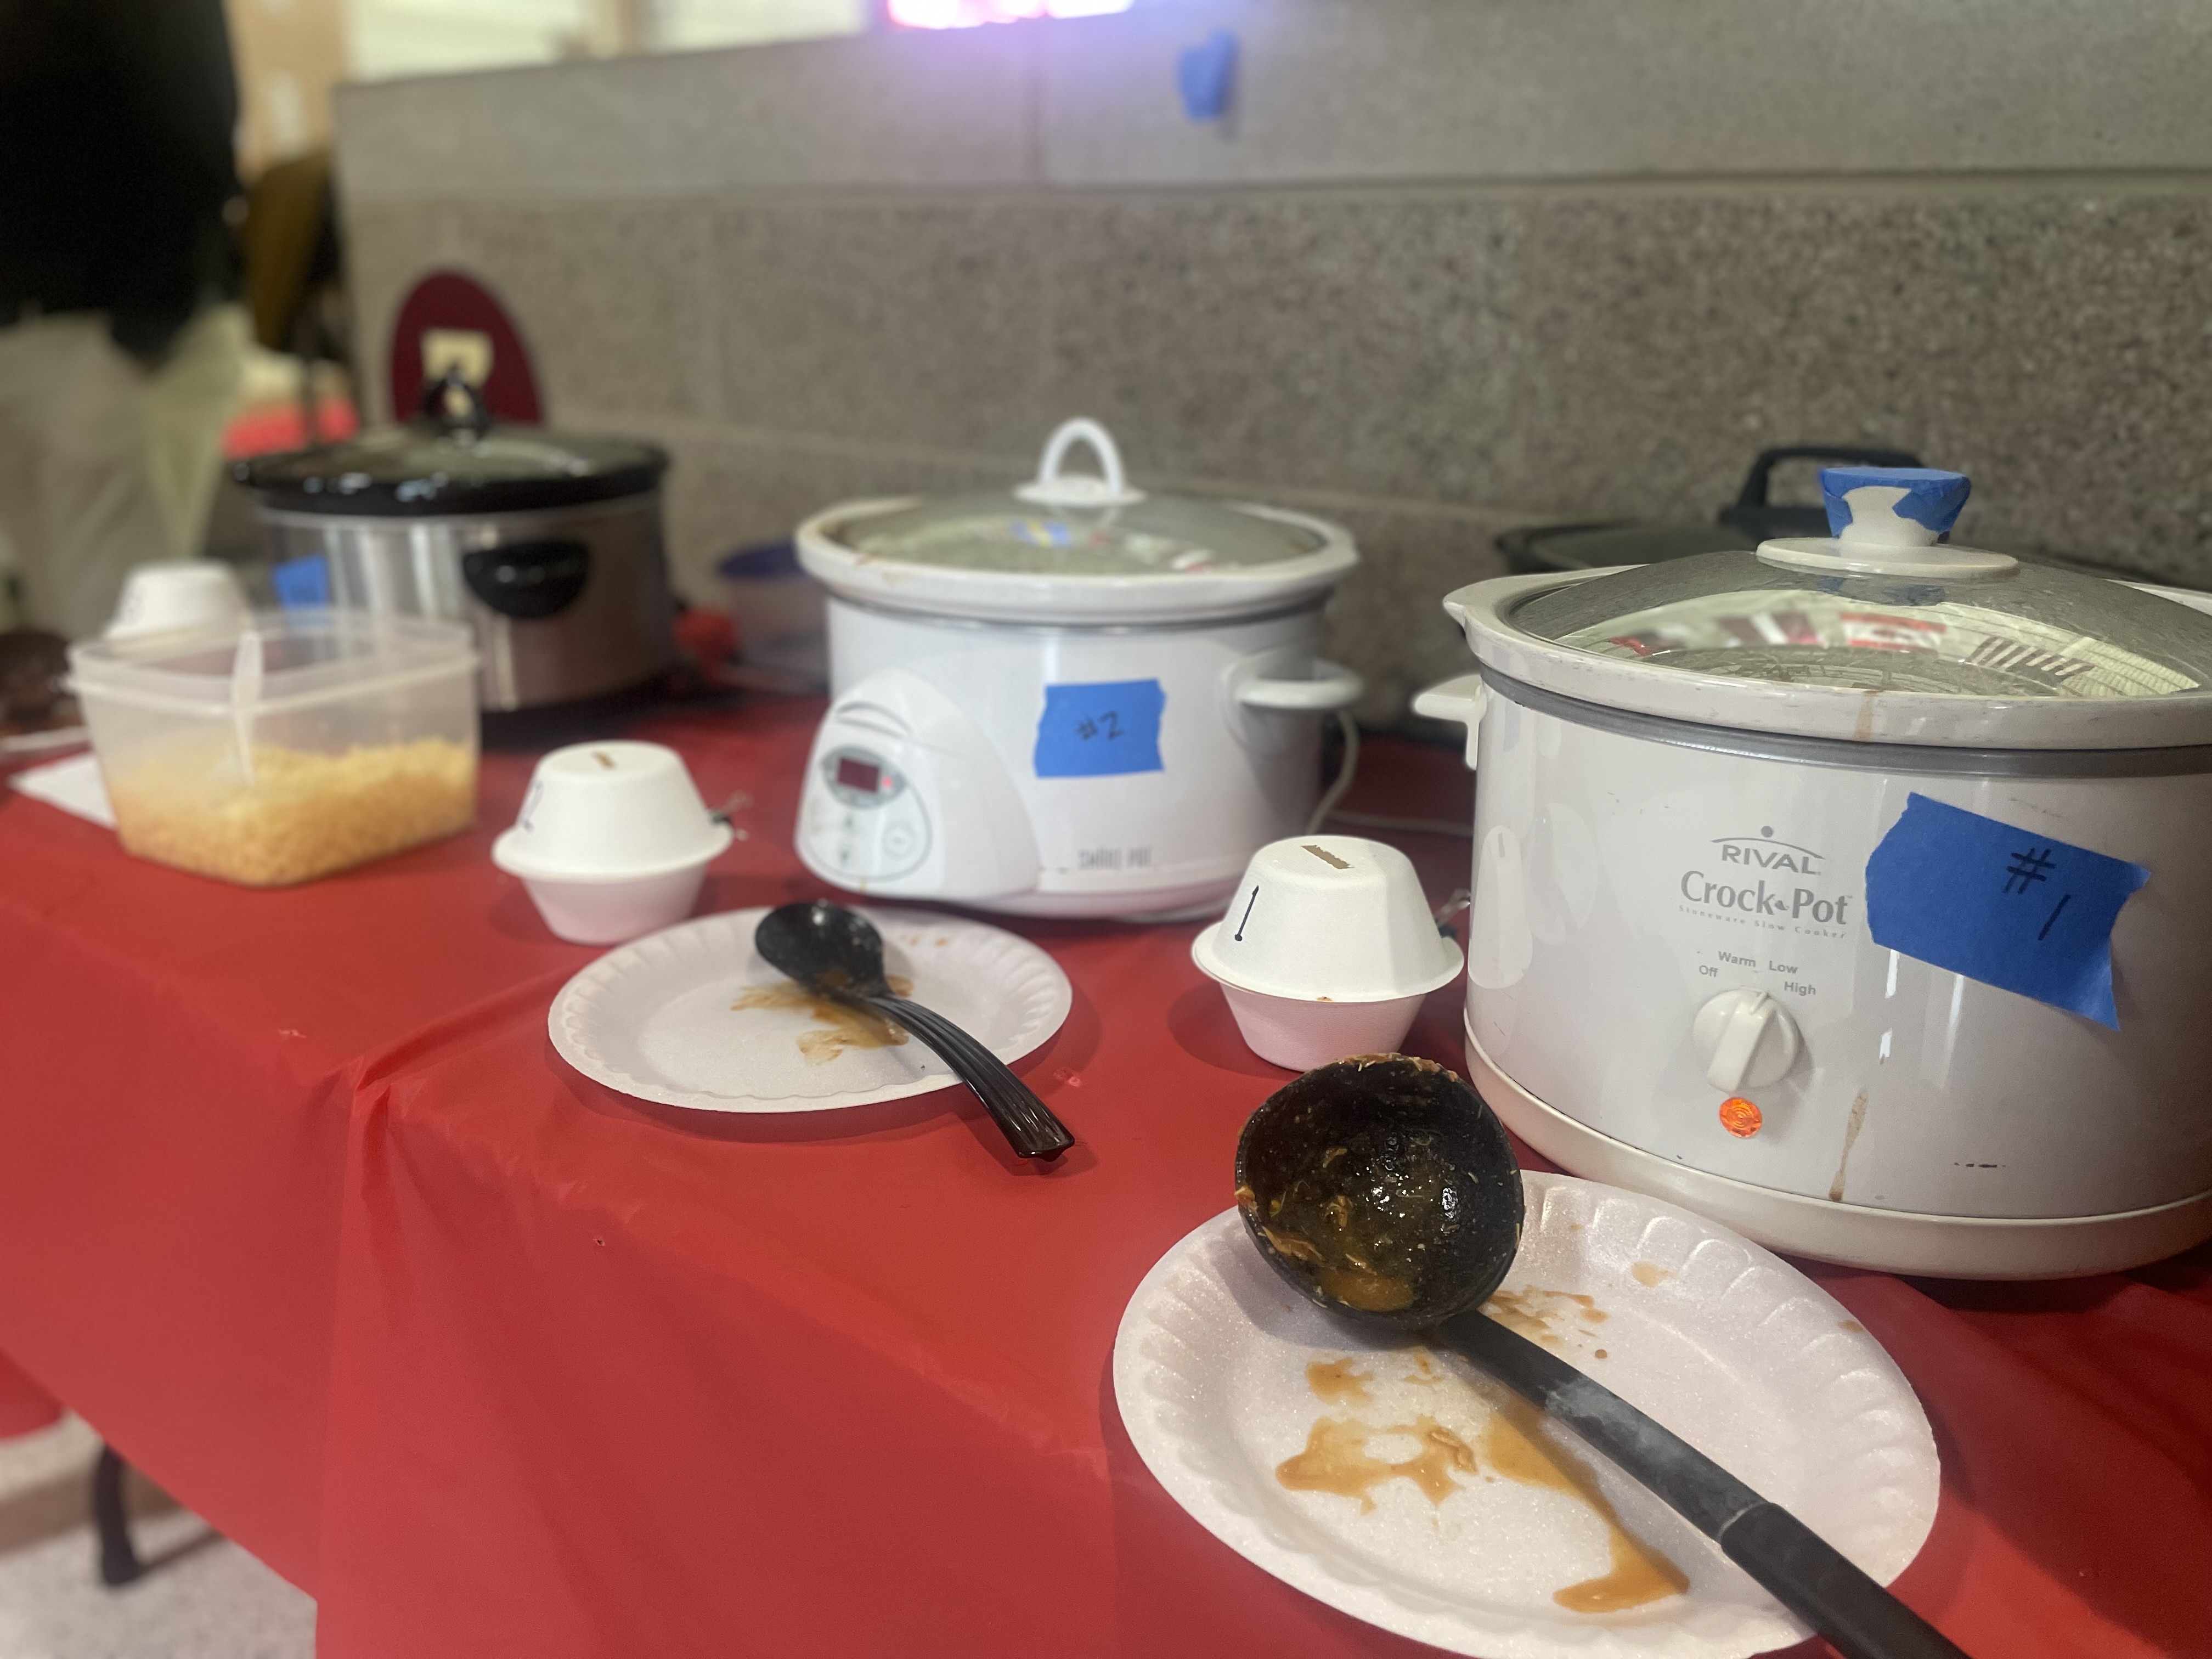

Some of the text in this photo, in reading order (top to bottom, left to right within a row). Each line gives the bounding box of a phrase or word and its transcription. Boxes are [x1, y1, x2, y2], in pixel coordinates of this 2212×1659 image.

[1075, 710, 1124, 741] #2
[1722, 844, 1818, 875] RIVAL
[1679, 905, 1846, 939] Stoneware Slow Cooker
[1718, 951, 1756, 967] Warm
[1699, 964, 1719, 978] Off
[1769, 961, 1798, 974] Low
[1784, 981, 1816, 996] High
